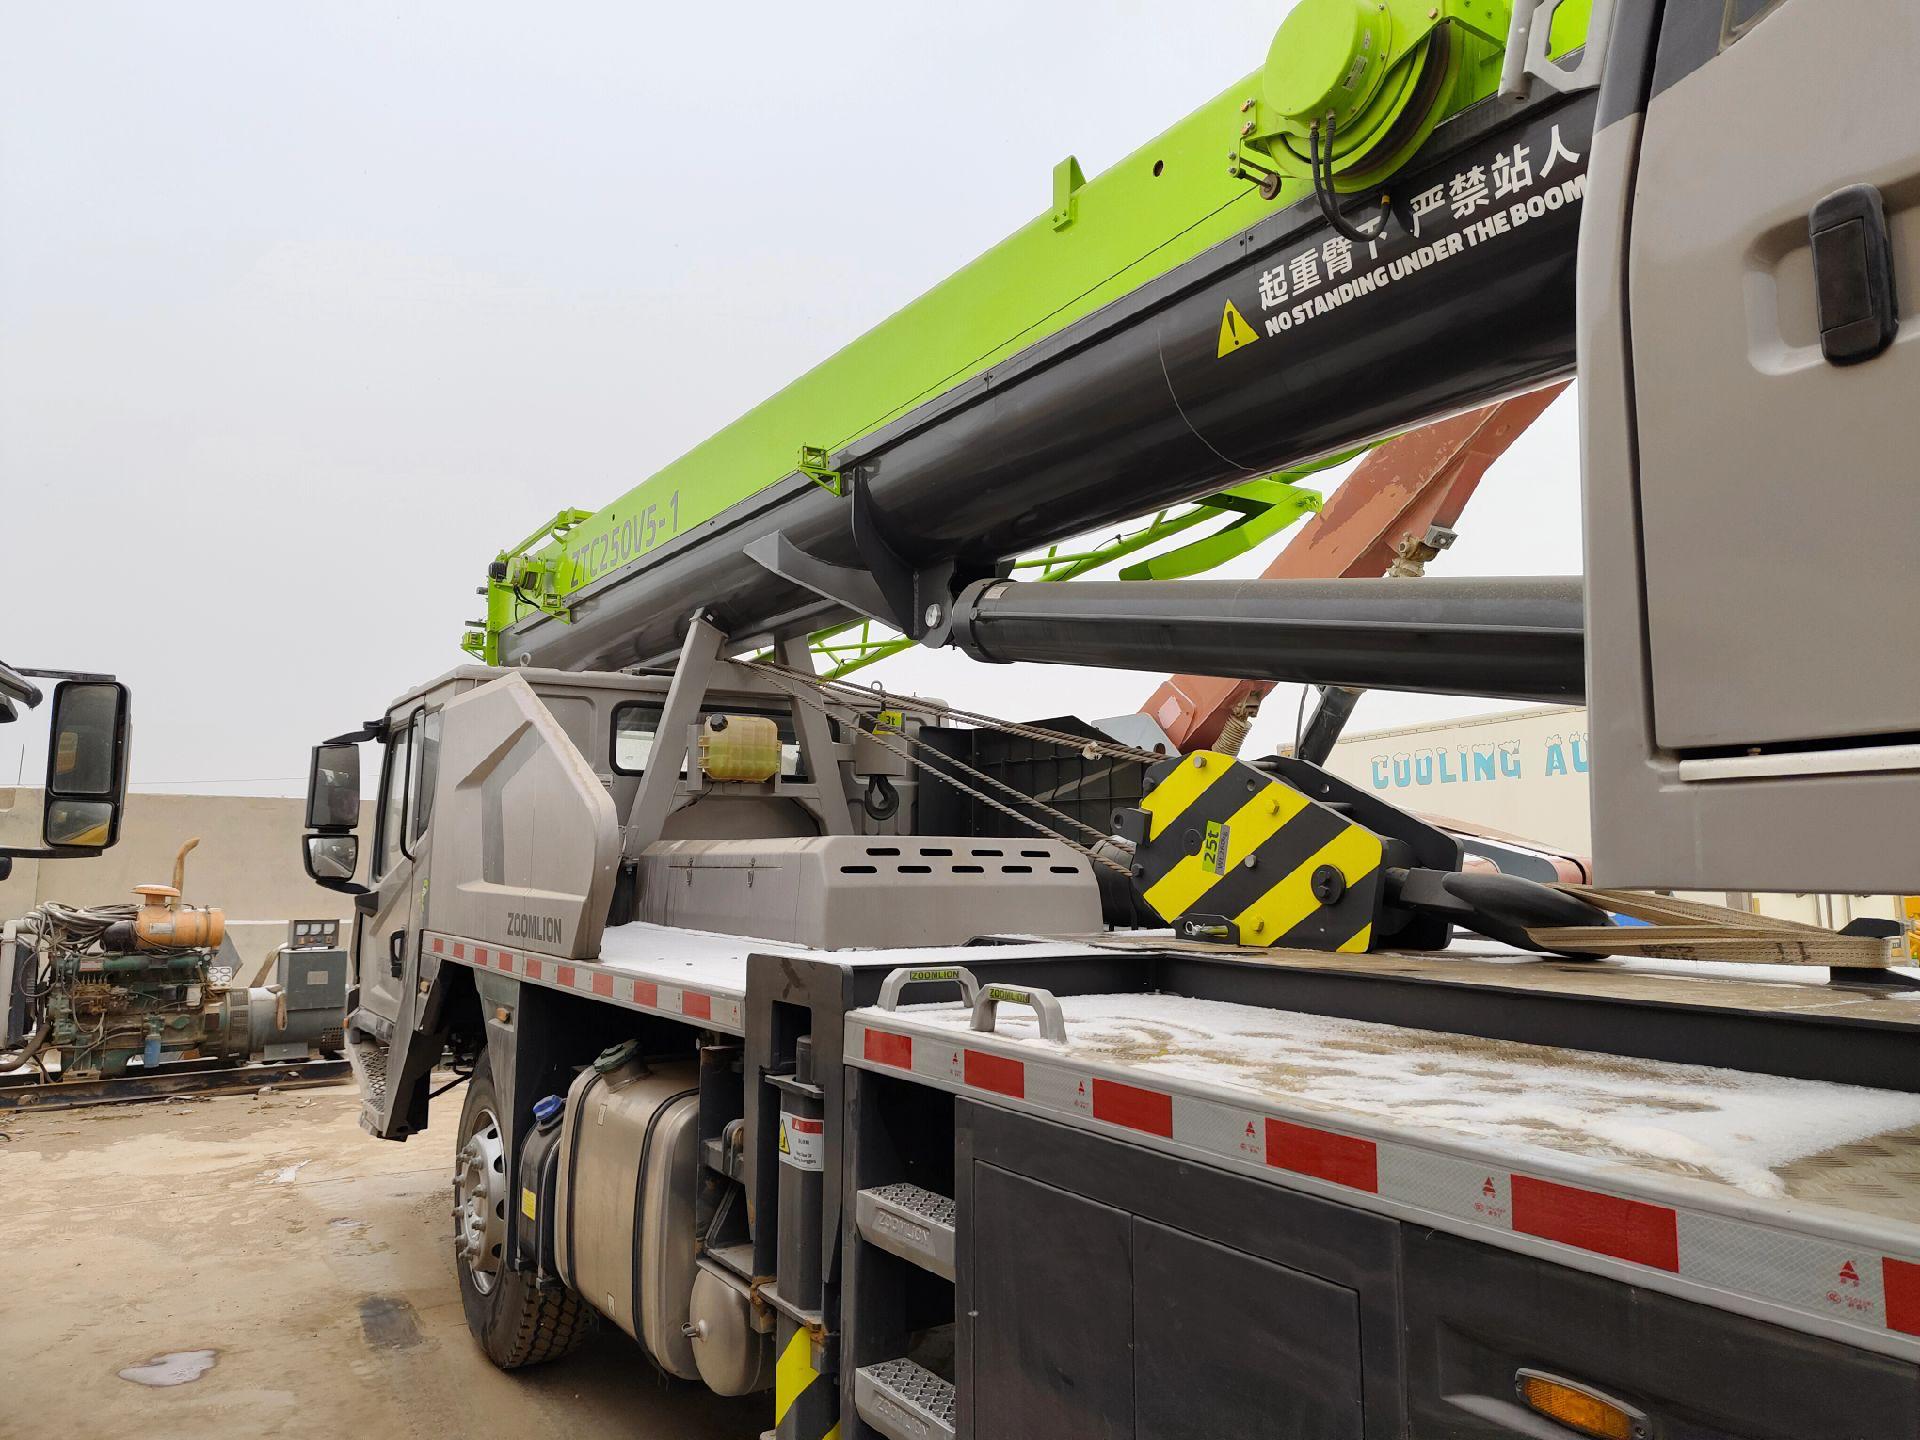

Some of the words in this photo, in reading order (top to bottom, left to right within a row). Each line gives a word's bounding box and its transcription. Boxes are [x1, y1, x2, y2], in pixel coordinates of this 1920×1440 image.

[1264, 313, 1292, 338] NO
[1291, 270, 1391, 328] STANDING
[1390, 232, 1465, 282] UNDER
[1463, 213, 1511, 250] THE
[1508, 172, 1588, 229] BOOM
[570, 489, 680, 588] ZTC250V5-1
[1370, 739, 1521, 790] COOLING
[1204, 829, 1219, 865] 25t
[506, 912, 562, 945] ZOOMLION
[911, 970, 960, 981] ZOOMLION
